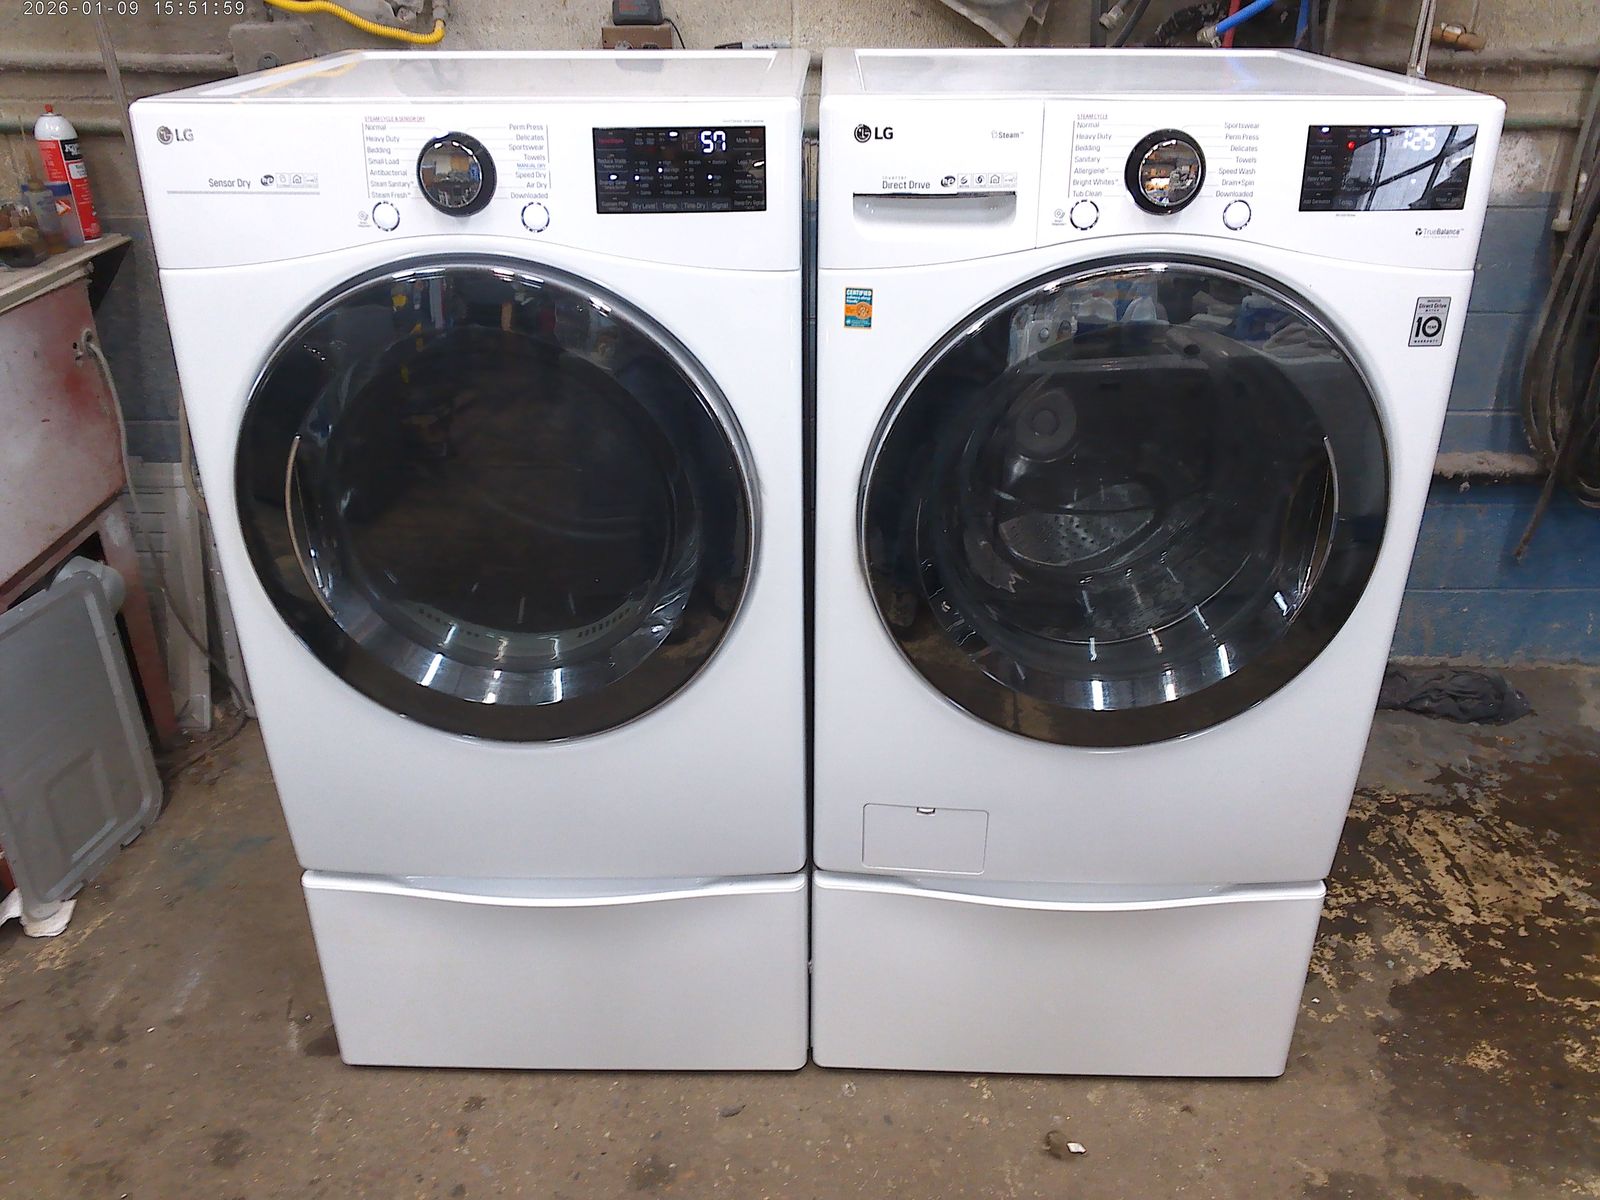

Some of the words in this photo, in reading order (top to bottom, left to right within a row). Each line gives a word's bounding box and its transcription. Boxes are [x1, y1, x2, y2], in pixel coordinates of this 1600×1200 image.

[175, 128, 194, 142] LG
[874, 126, 894, 140] LG
[366, 135, 385, 143] Heavy
[385, 135, 400, 143] Duty
[700, 130, 726, 153] 57
[367, 146, 391, 154] Bedding
[208, 178, 235, 188] Sensor
[236, 178, 251, 189] Dry
[536, 181, 548, 189] Dry
[882, 180, 907, 189] Direct
[908, 180, 931, 189] Drive
[1072, 179, 1092, 187] Bright
[371, 191, 390, 199] Steam
[1215, 190, 1254, 198] Downloaded
[1414, 315, 1442, 338] 10
